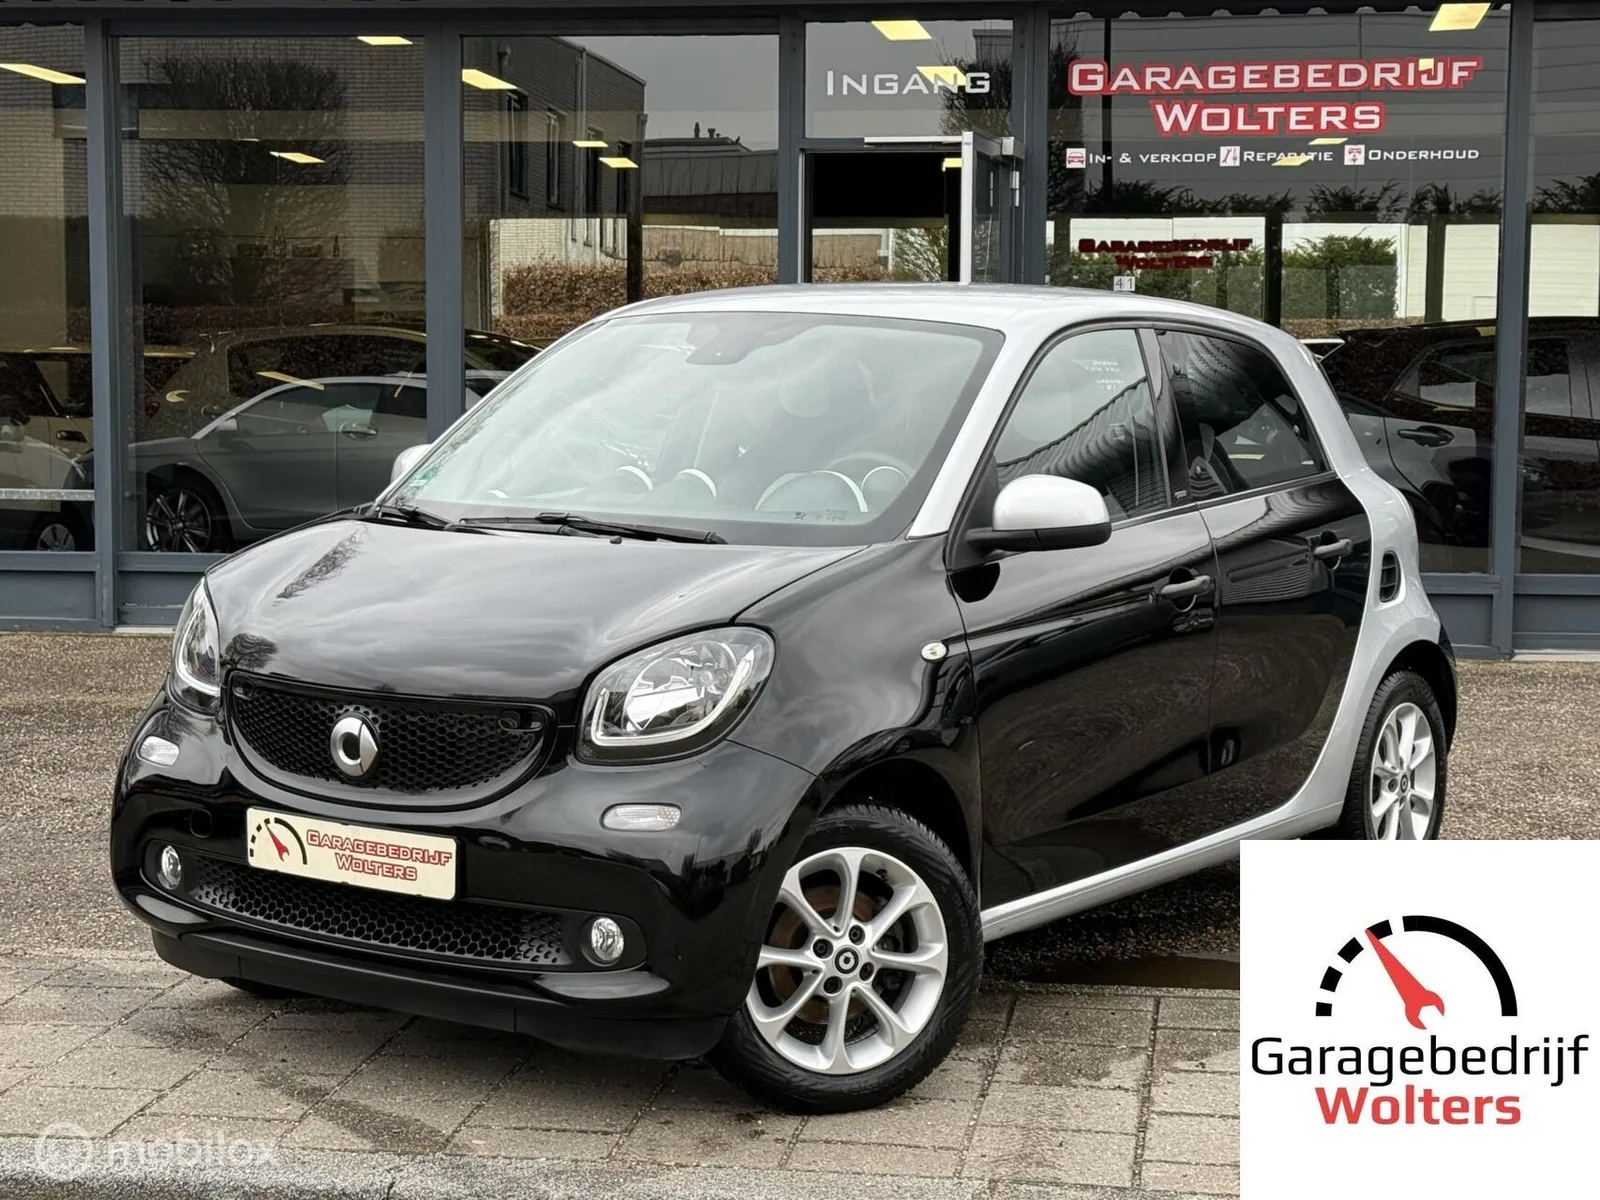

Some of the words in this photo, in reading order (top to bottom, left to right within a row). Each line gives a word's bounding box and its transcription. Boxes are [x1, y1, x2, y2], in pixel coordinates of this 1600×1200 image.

[826, 70, 991, 96] INGANG
[1153, 101, 1383, 134] WOLTERS
[1119, 153, 1132, 164] &
[1243, 151, 1333, 162] REPATIE
[1368, 149, 1480, 161] ONDERHOUD
[335, 852, 418, 881] WOLTERS
